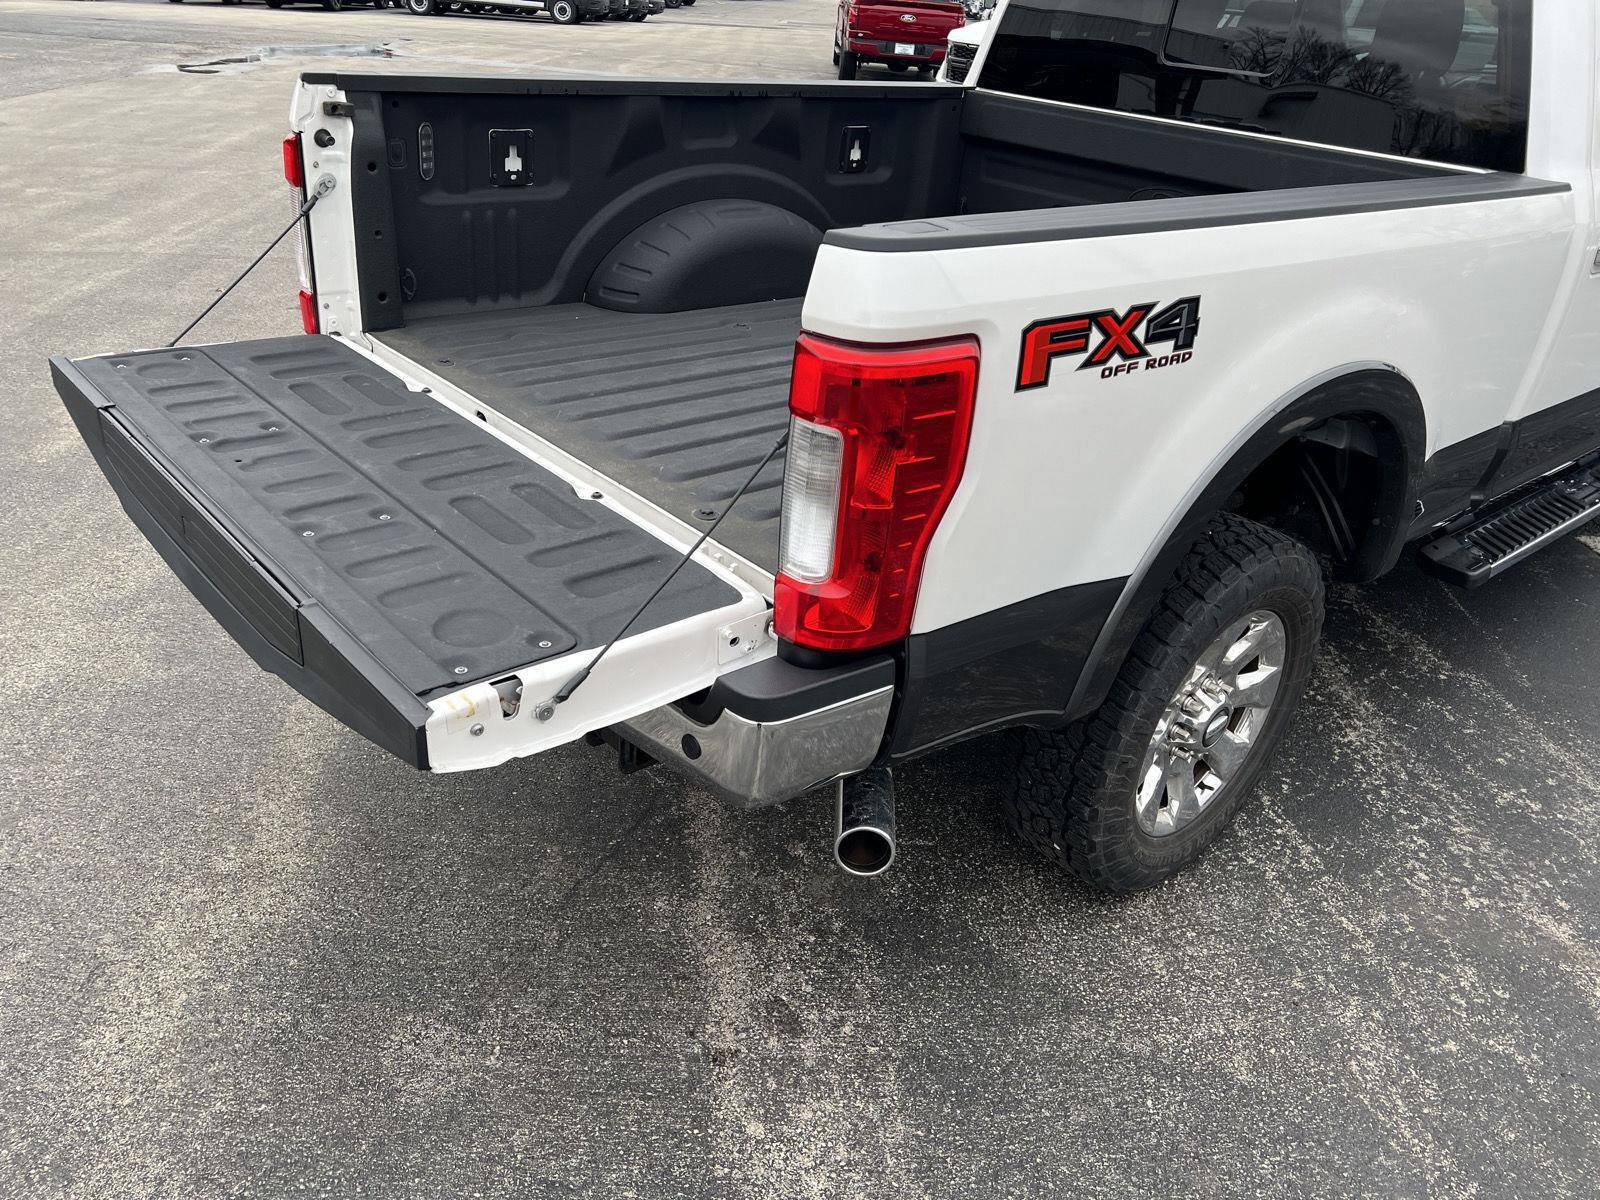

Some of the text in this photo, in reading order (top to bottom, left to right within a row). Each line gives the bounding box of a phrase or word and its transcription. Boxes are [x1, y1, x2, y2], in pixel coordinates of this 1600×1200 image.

[1014, 294, 1201, 393] FX4
[1100, 351, 1193, 379] OFF ROAD
